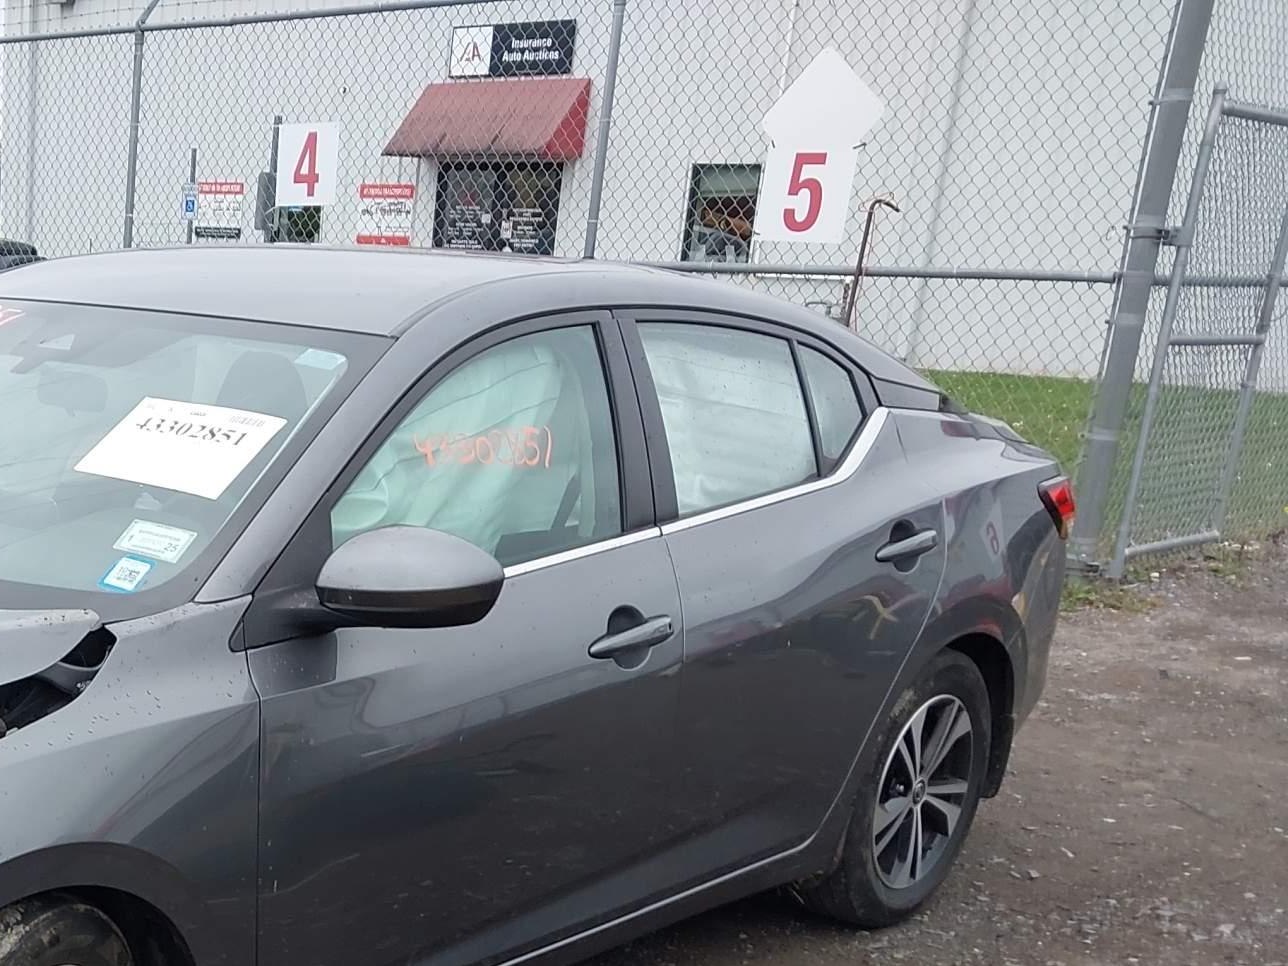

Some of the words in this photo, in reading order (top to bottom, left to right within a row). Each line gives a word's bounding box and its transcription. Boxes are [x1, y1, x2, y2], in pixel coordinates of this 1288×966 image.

[501, 50, 522, 62] Auto
[523, 48, 560, 61] Auctions
[511, 37, 552, 49] Insurance
[293, 131, 319, 197] 4
[783, 151, 828, 232] 5
[135, 416, 248, 446] 43302851
